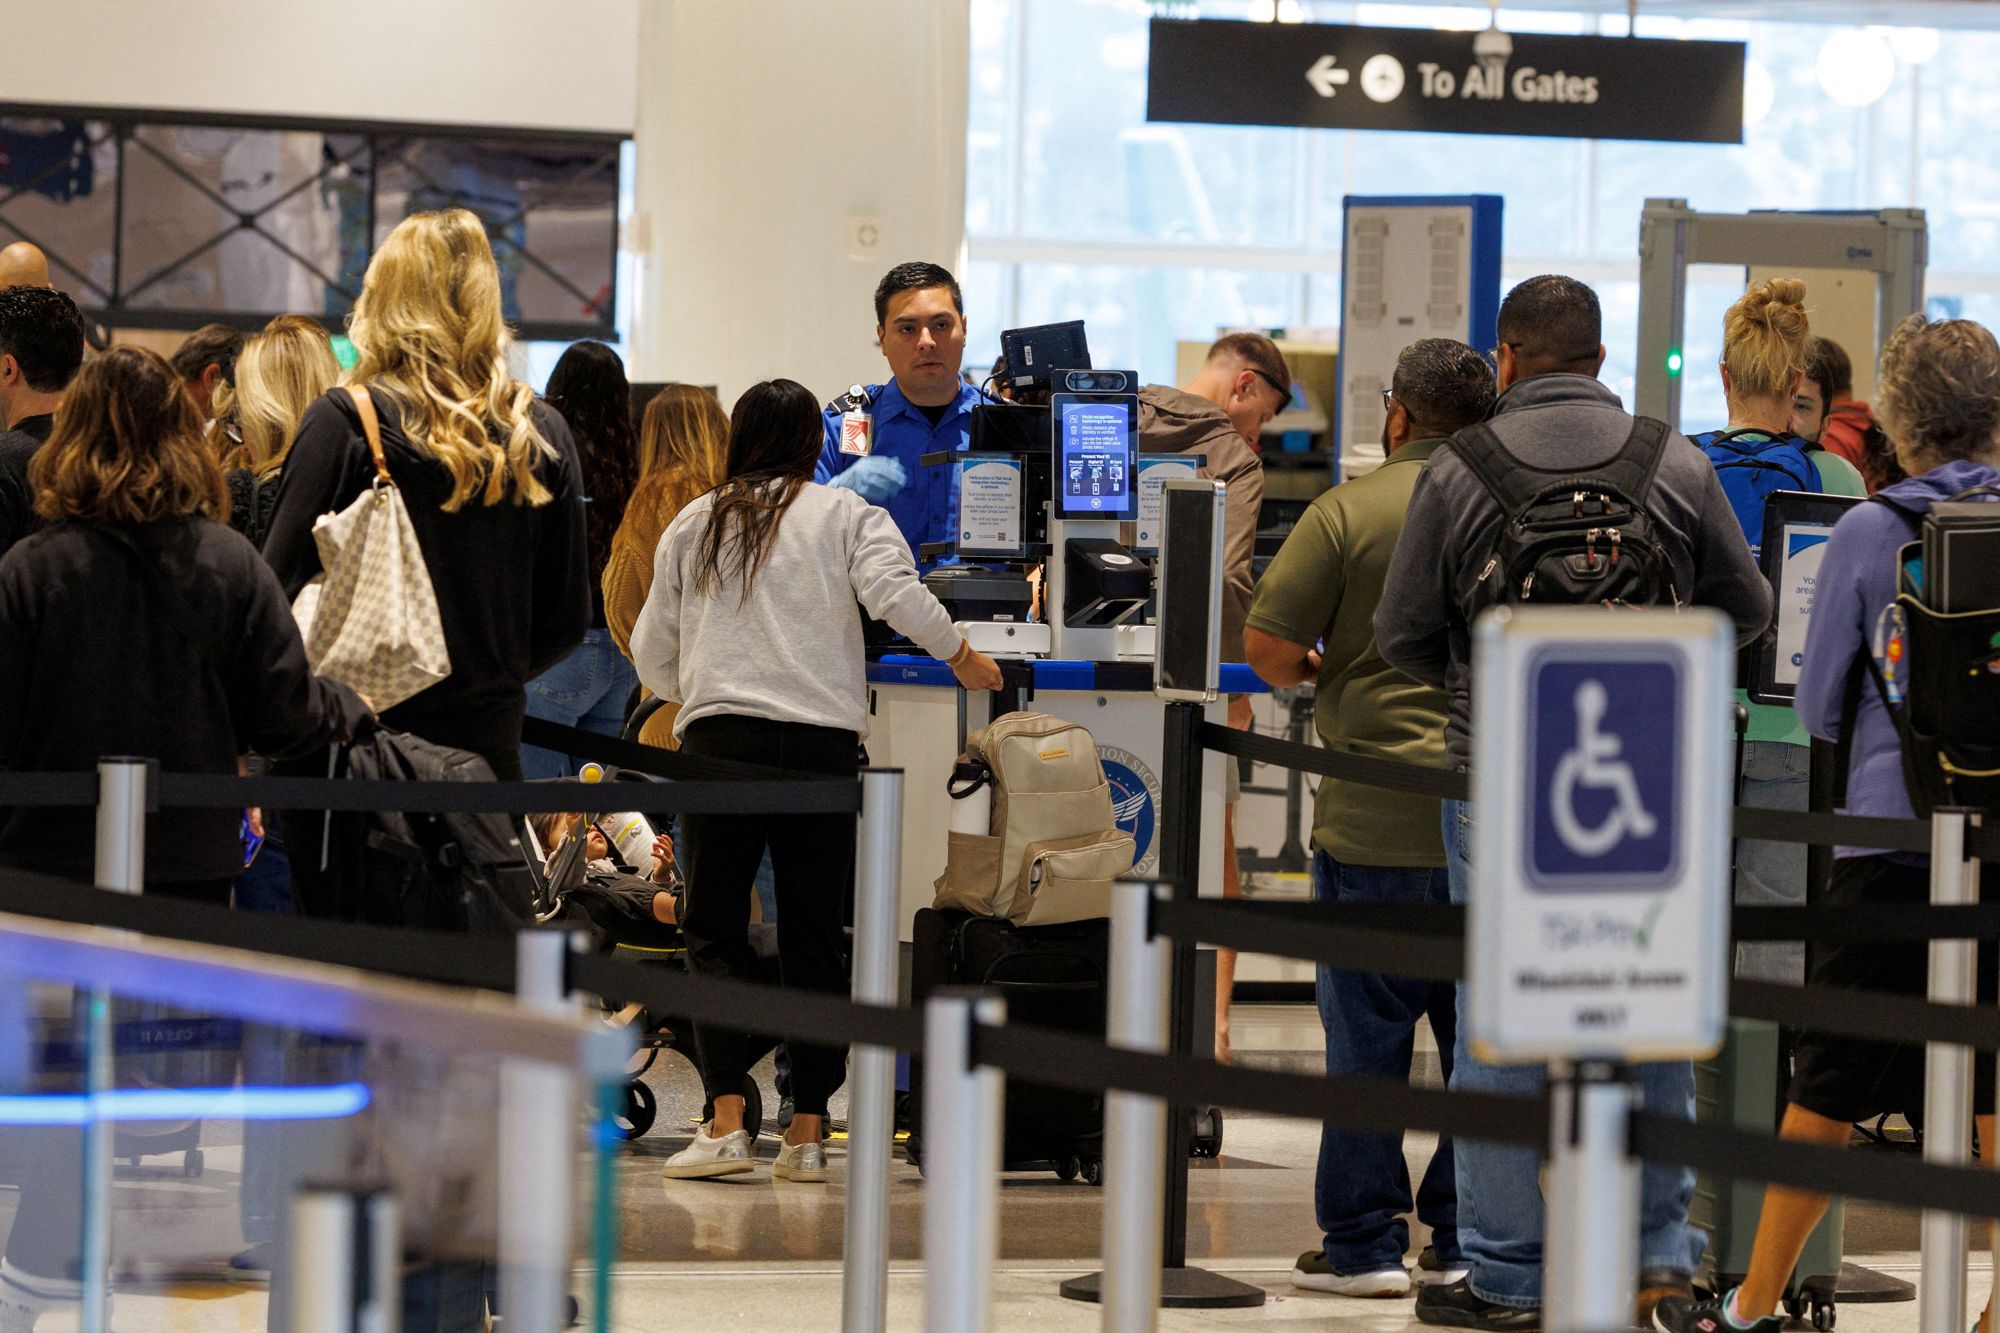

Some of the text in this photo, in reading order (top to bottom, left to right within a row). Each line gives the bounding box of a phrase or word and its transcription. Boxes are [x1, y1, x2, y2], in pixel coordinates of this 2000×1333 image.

[1417, 61, 1600, 104] To All Gates
